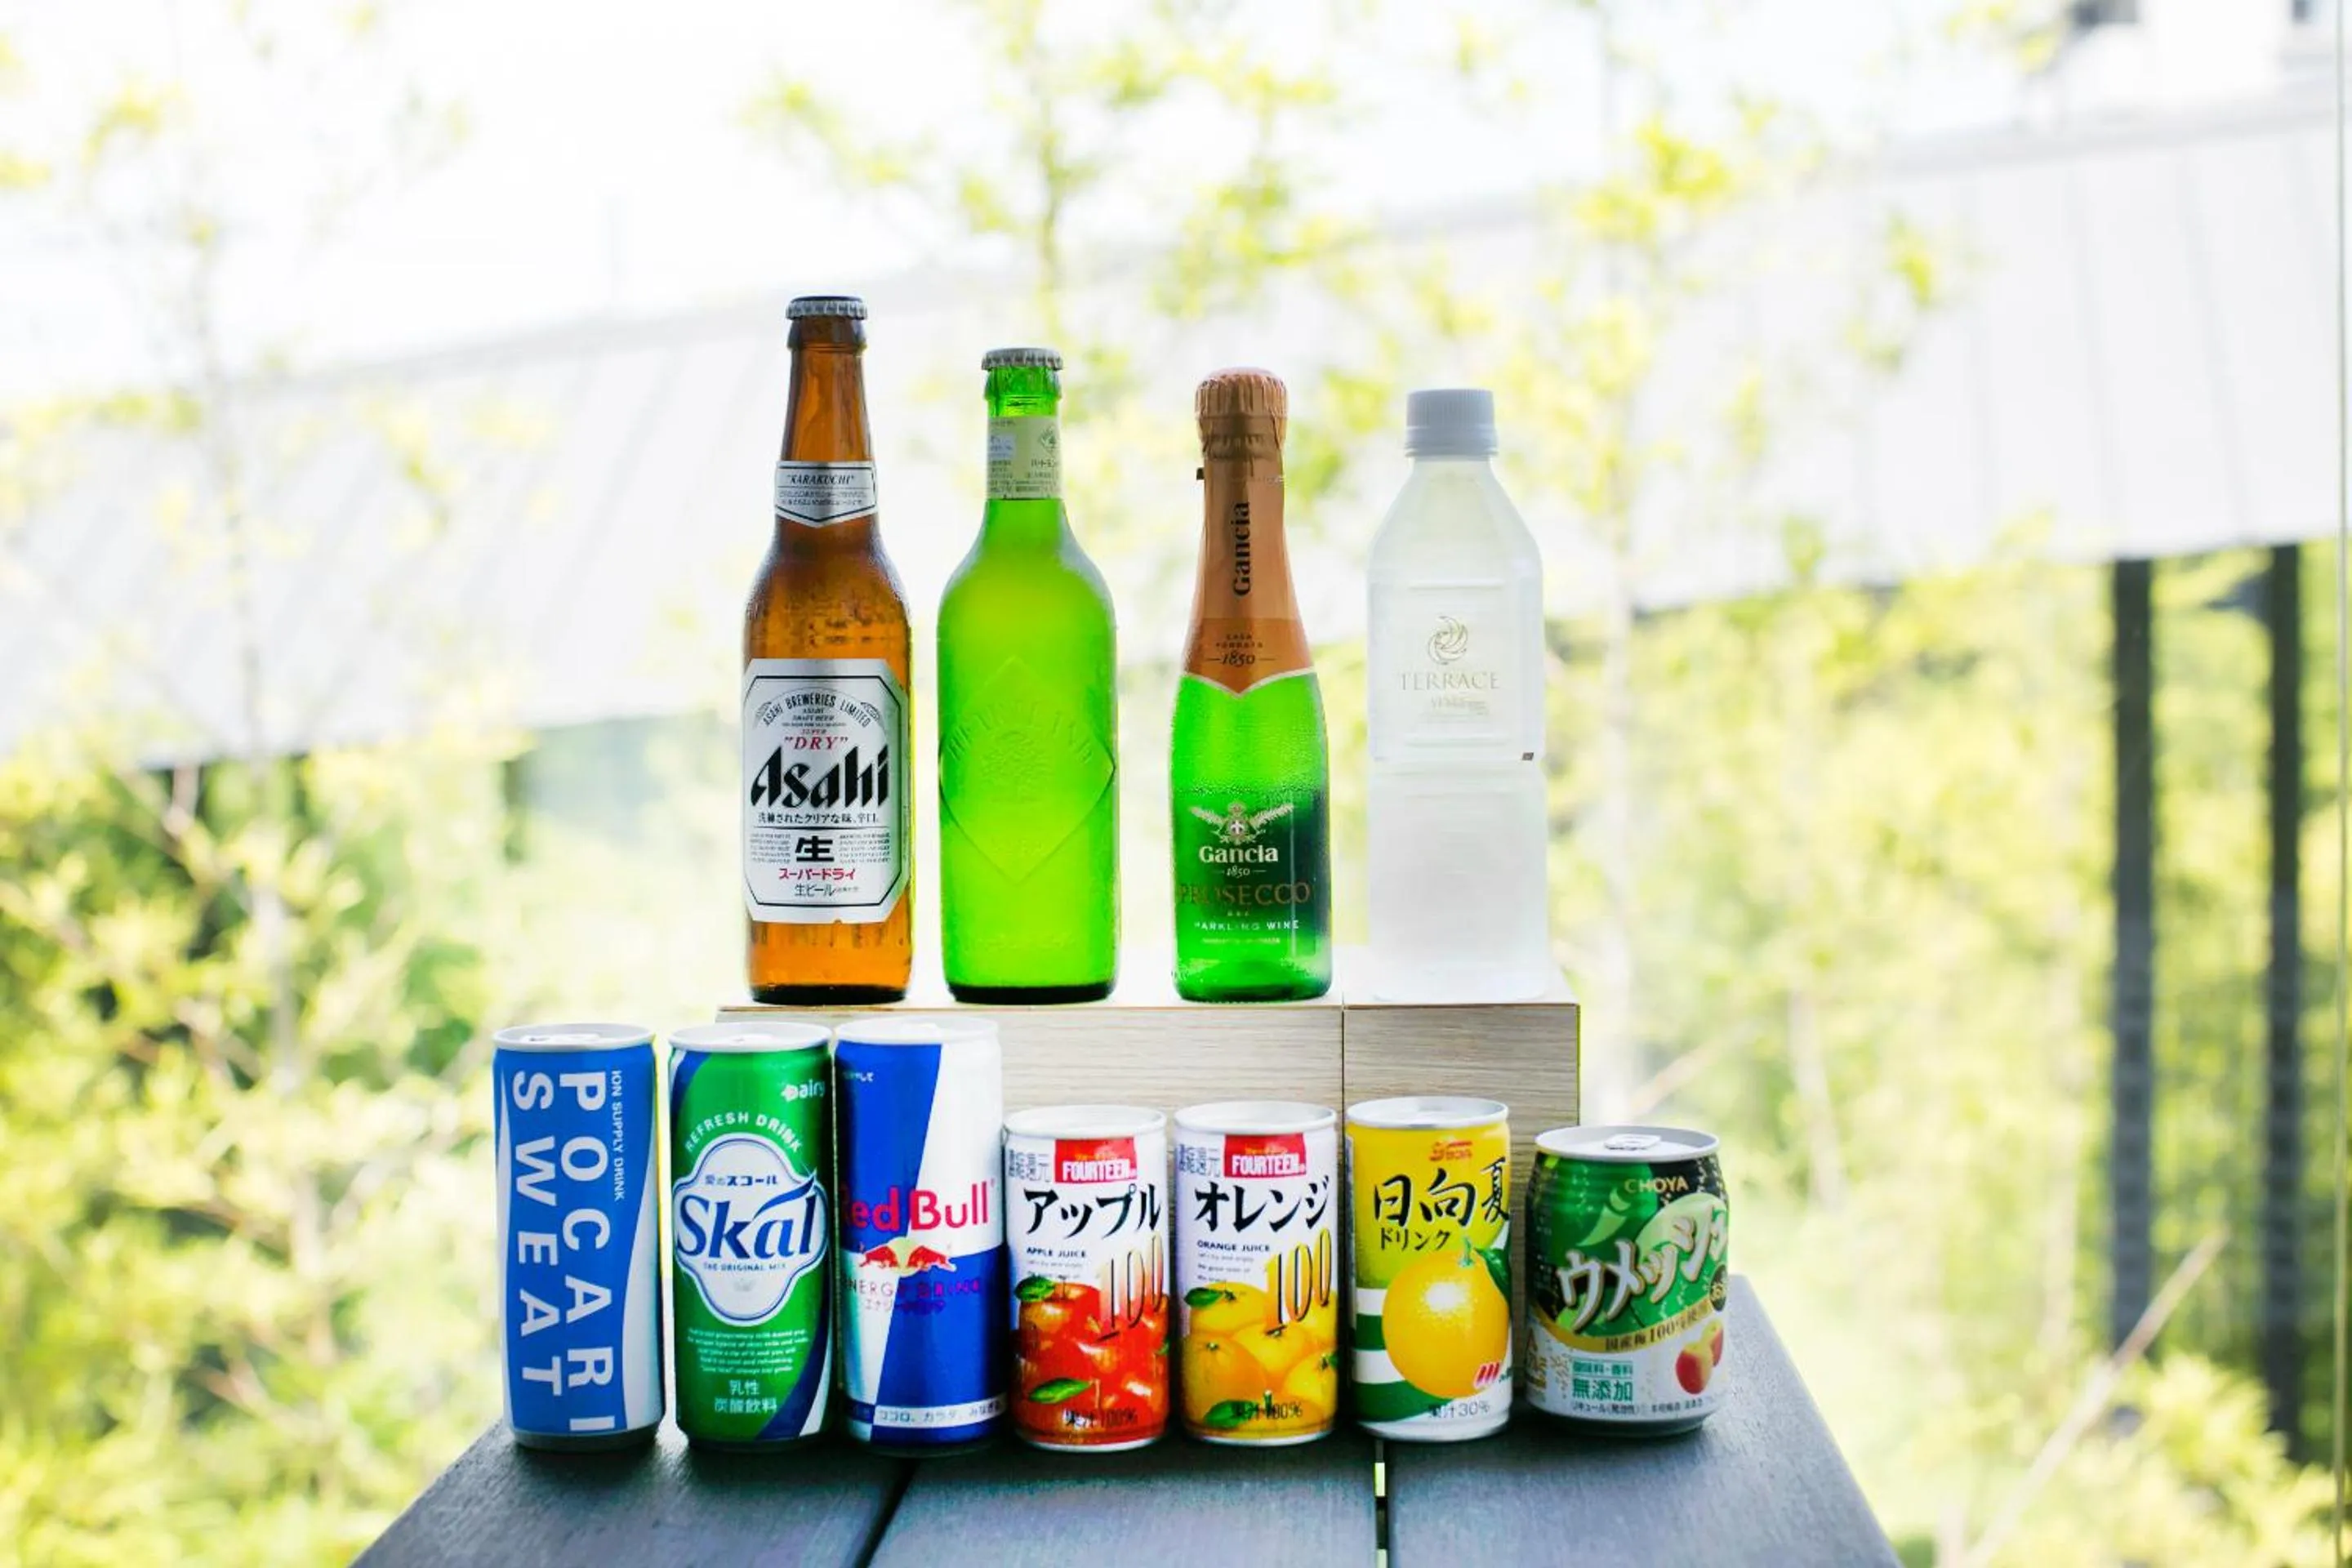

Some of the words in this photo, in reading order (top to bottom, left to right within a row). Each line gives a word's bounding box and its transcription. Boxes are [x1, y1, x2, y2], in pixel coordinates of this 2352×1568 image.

[1231, 501, 1251, 596] Gancia
[1397, 670, 1501, 691] TERRACE
[785, 692, 836, 710] BREWERIES
[840, 699, 873, 728] LIMITED
[751, 744, 889, 808] Asahi
[795, 835, 835, 862] 生
[1199, 844, 1279, 863] Gancia
[779, 867, 856, 880] スーパードライ
[1227, 865, 1250, 880] 1850
[1267, 920, 1299, 930] WINE
[612, 1071, 622, 1097] ION
[612, 1102, 624, 1153] SUPPLY
[685, 1111, 750, 1152] REFRESH
[755, 1114, 804, 1152] DRINK
[1062, 1158, 1130, 1182] FOURTEEN
[1232, 1152, 1299, 1175] FOURTEEN
[614, 1157, 626, 1201] DRINK
[1374, 1156, 1510, 1227] 日向夏
[1624, 1176, 1689, 1194] CHOYA
[910, 1180, 988, 1231] Bull
[1024, 1183, 1161, 1241] アップル
[1195, 1174, 1330, 1232] オレンジ
[512, 1071, 562, 1396] SWEAT
[1197, 1239, 1236, 1251] ORANGE
[1242, 1244, 1270, 1252] JUICE
[1381, 1227, 1450, 1251] ドリンク
[559, 1070, 617, 1432] POCARI
[1027, 1246, 1053, 1256] APPLE
[1058, 1250, 1086, 1258] JUICE
[721, 1263, 763, 1272] ORIGINAL
[1266, 1227, 1332, 1334] 100
[729, 1379, 760, 1396] 乳性
[1573, 1379, 1633, 1402] 無添加
[715, 1397, 777, 1414] 炭酸飲料
